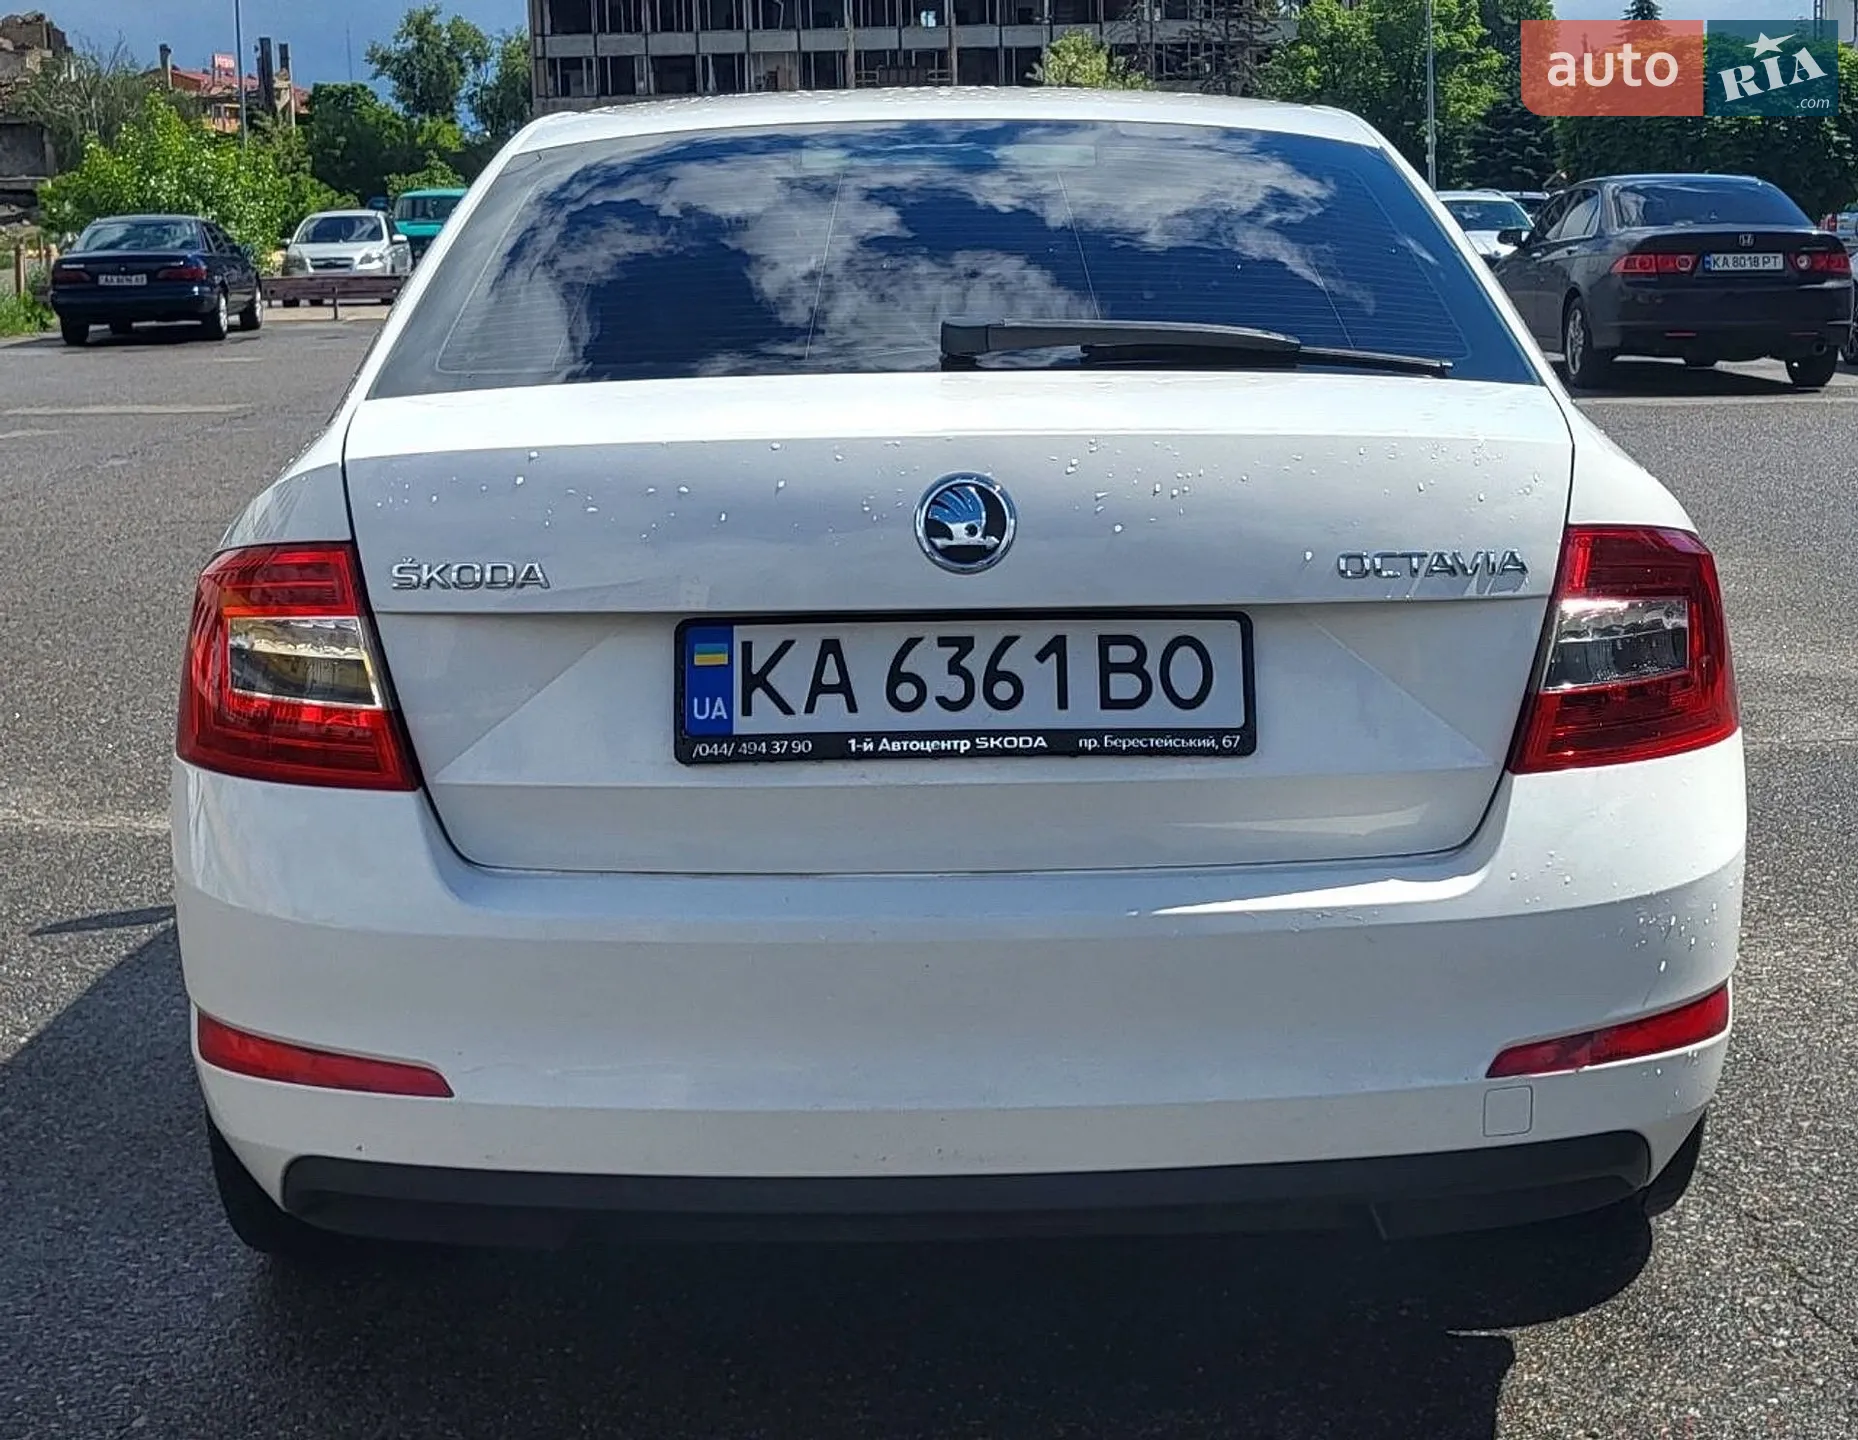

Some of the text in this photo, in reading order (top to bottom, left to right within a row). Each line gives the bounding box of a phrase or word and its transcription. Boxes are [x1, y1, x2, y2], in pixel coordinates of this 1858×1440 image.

[1712, 256, 1729, 268] KA
[1762, 254, 1779, 267] PT
[391, 557, 551, 590] ŠKODA
[1337, 549, 1529, 579] OCTAVIA
[741, 634, 1214, 717] KA 6361 BO
[693, 696, 728, 720] UA
[692, 734, 1241, 759] /044/ 494 37 90 1-й Автоцентр SKODA пр. Берестейський, 67
